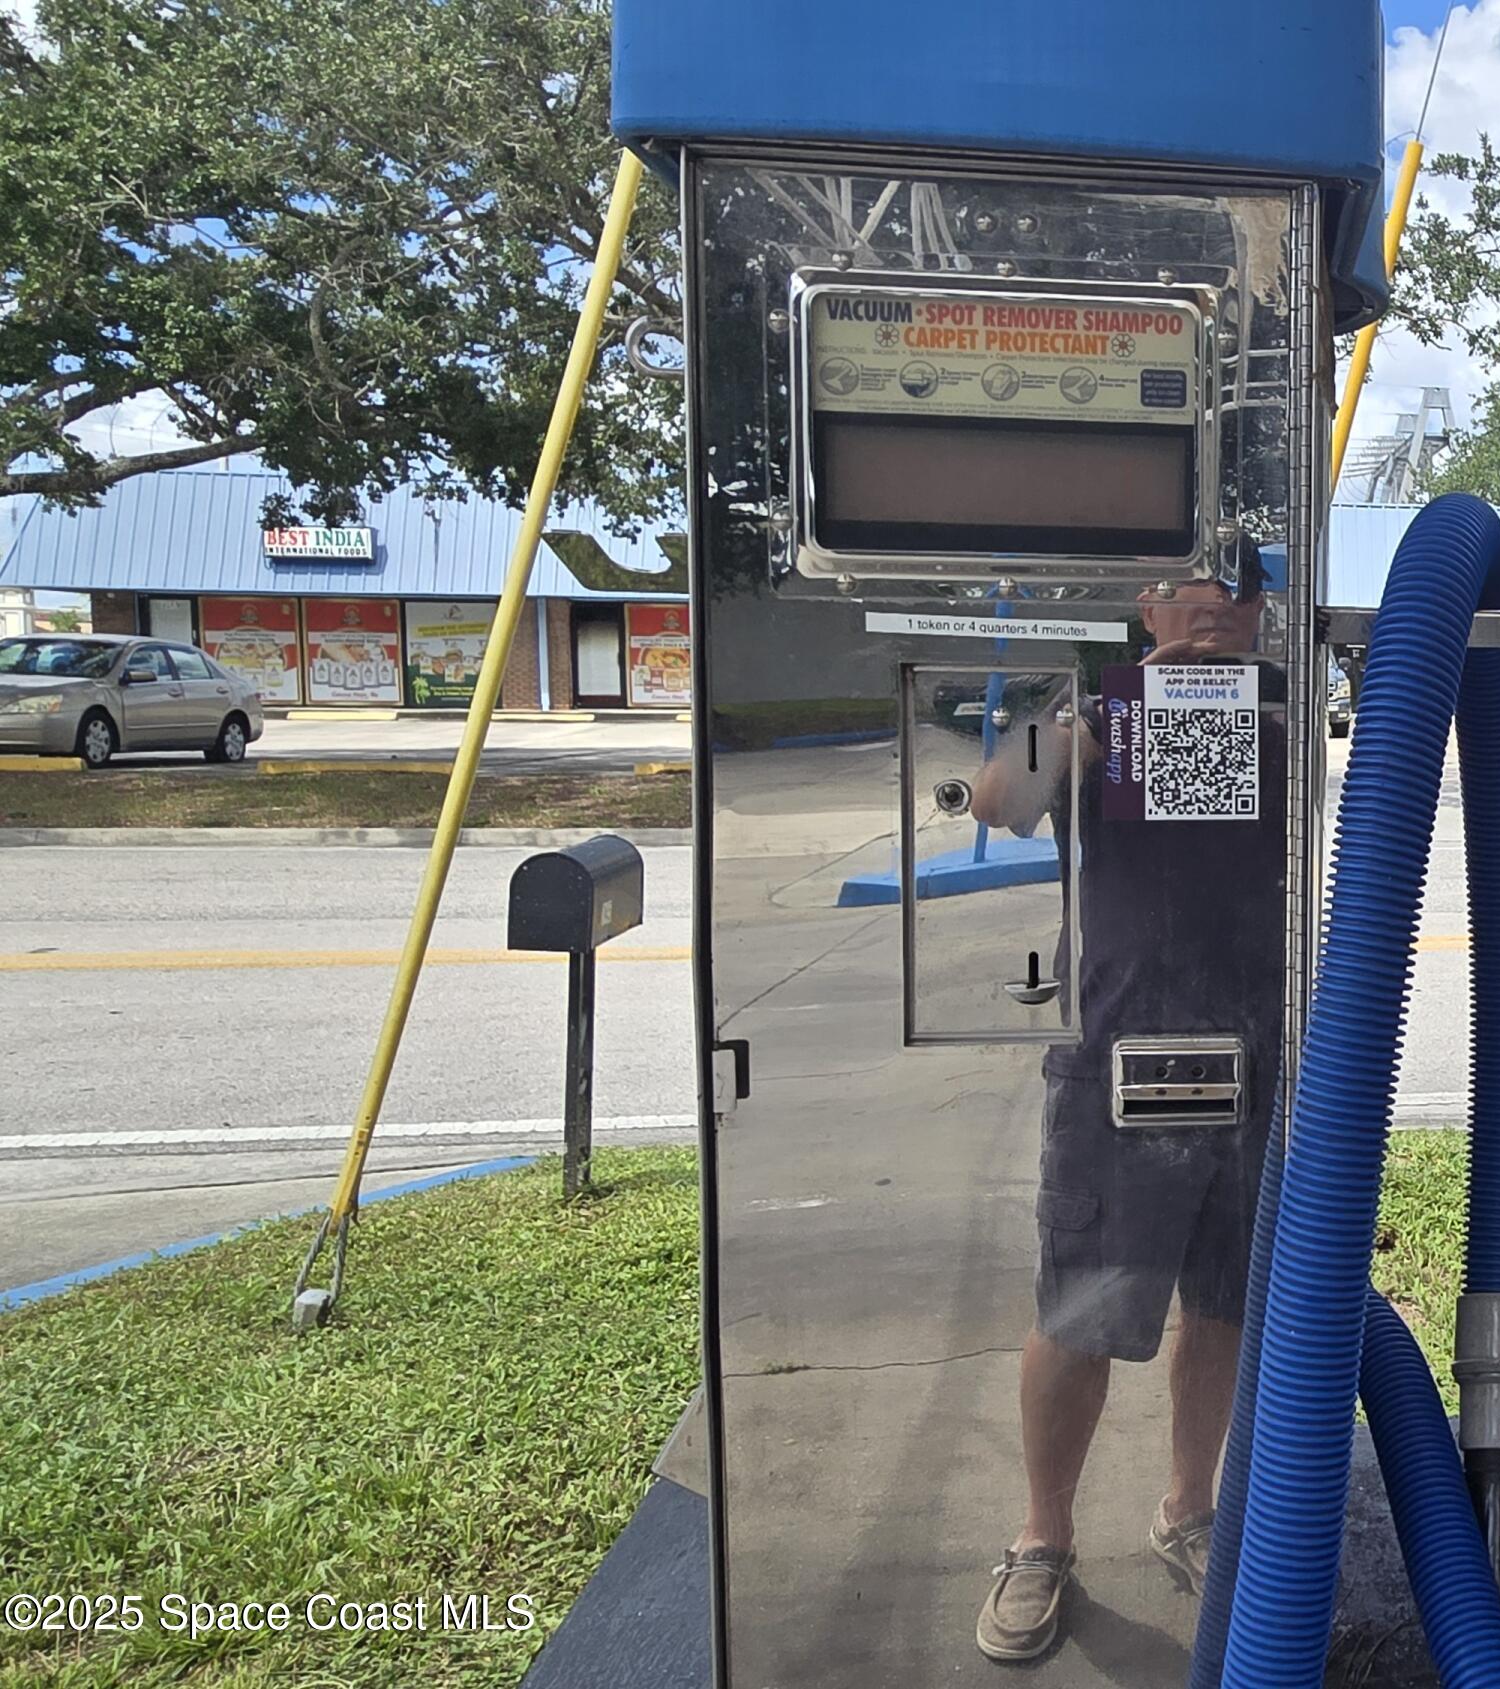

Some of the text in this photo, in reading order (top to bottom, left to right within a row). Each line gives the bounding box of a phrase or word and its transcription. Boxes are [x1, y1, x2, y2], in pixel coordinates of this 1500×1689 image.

[826, 299, 1184, 336] VACUUM SPOT REMOVER SHAMPOO
[903, 326, 1110, 356] CARPET PROTECTANT
[267, 529, 366, 547] BEST INDIA
[265, 547, 368, 556] INTERNATIONAL FOODS
[907, 618, 1088, 636] 1 token or 4 quarters 4 minutes
[1165, 678, 1238, 686] APP OR SELECT
[1164, 688, 1240, 699] VACUUM 6
[1131, 700, 1143, 783] DOWNLOAD
